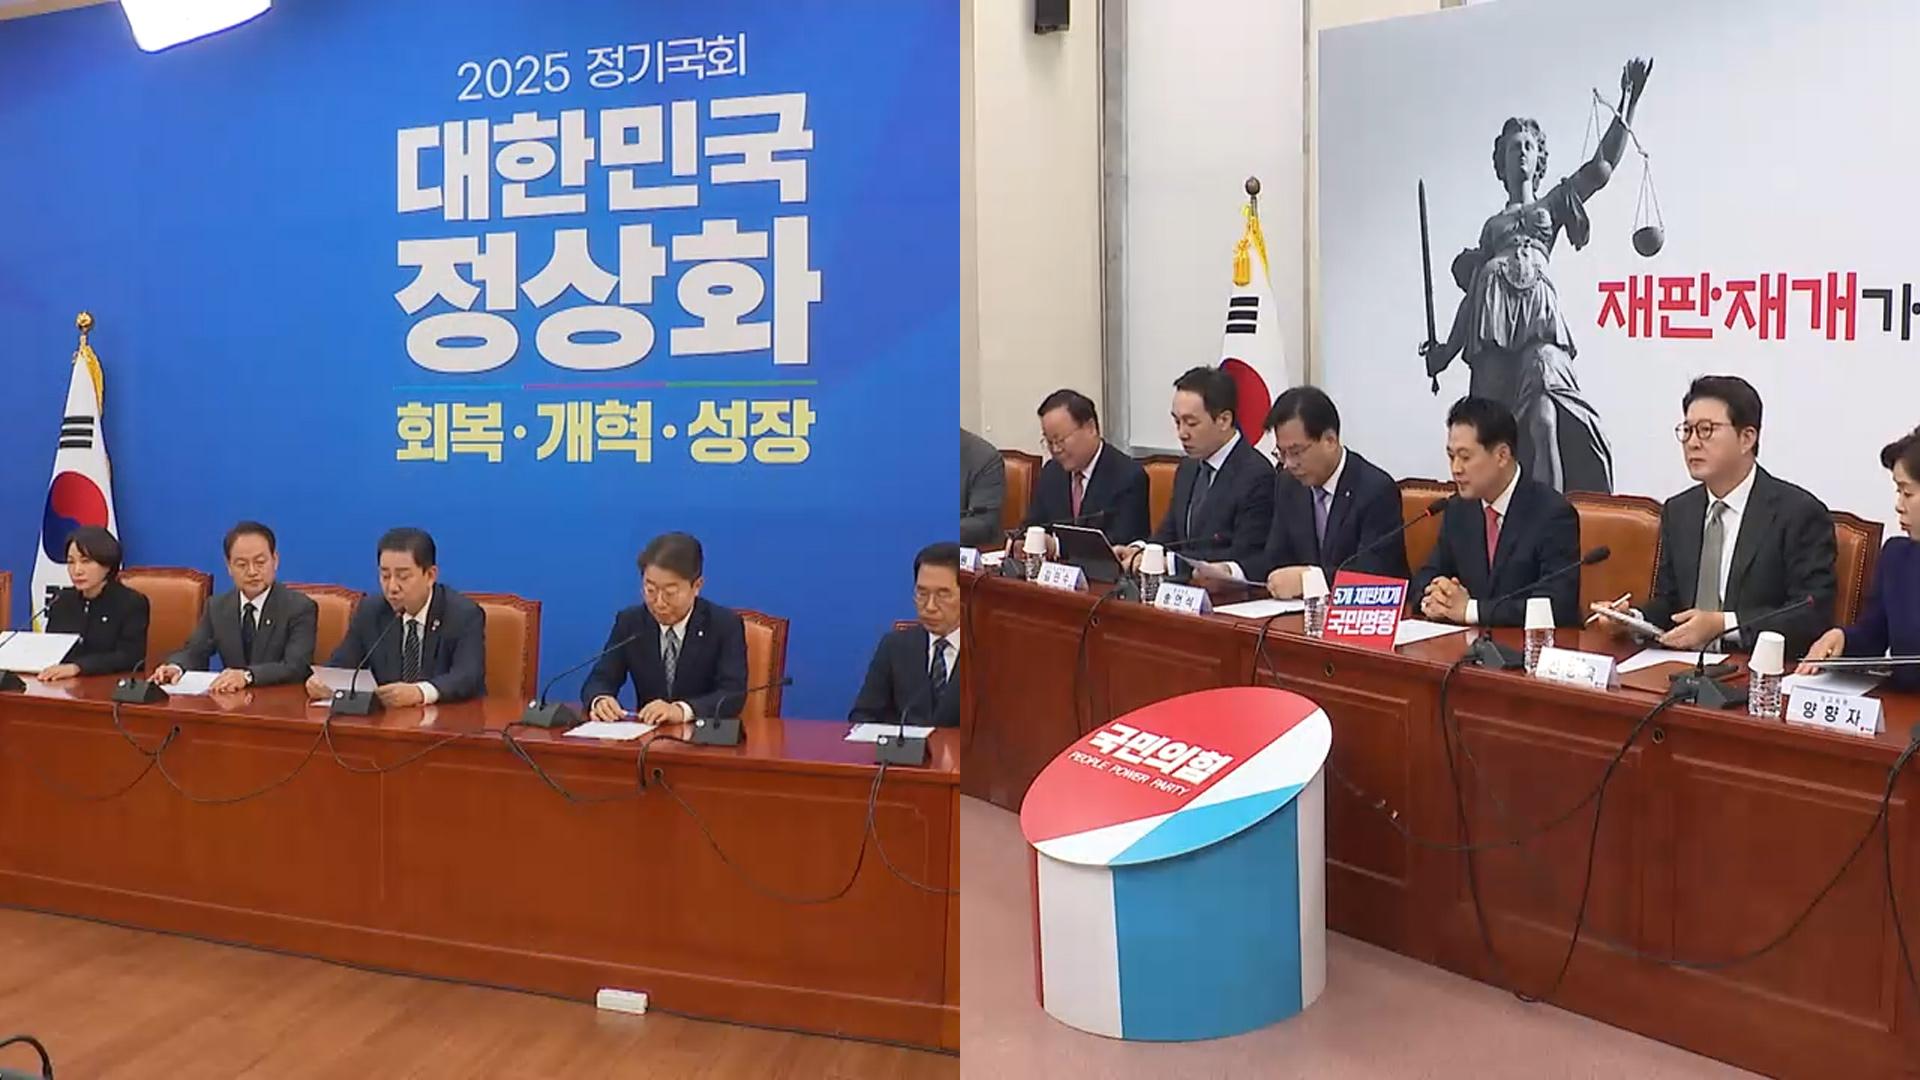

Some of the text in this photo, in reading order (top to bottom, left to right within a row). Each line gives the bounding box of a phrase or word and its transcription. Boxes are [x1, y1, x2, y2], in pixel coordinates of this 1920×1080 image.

[456, 32, 748, 102] 2025 정기국회
[396, 92, 814, 222] 대한민국
[393, 214, 823, 374] 정상화
[1326, 608, 1398, 636] 국민명령
[1067, 750, 1192, 796] PEOPLE POWER PARTY
[1087, 721, 1235, 786] 국민의힘
